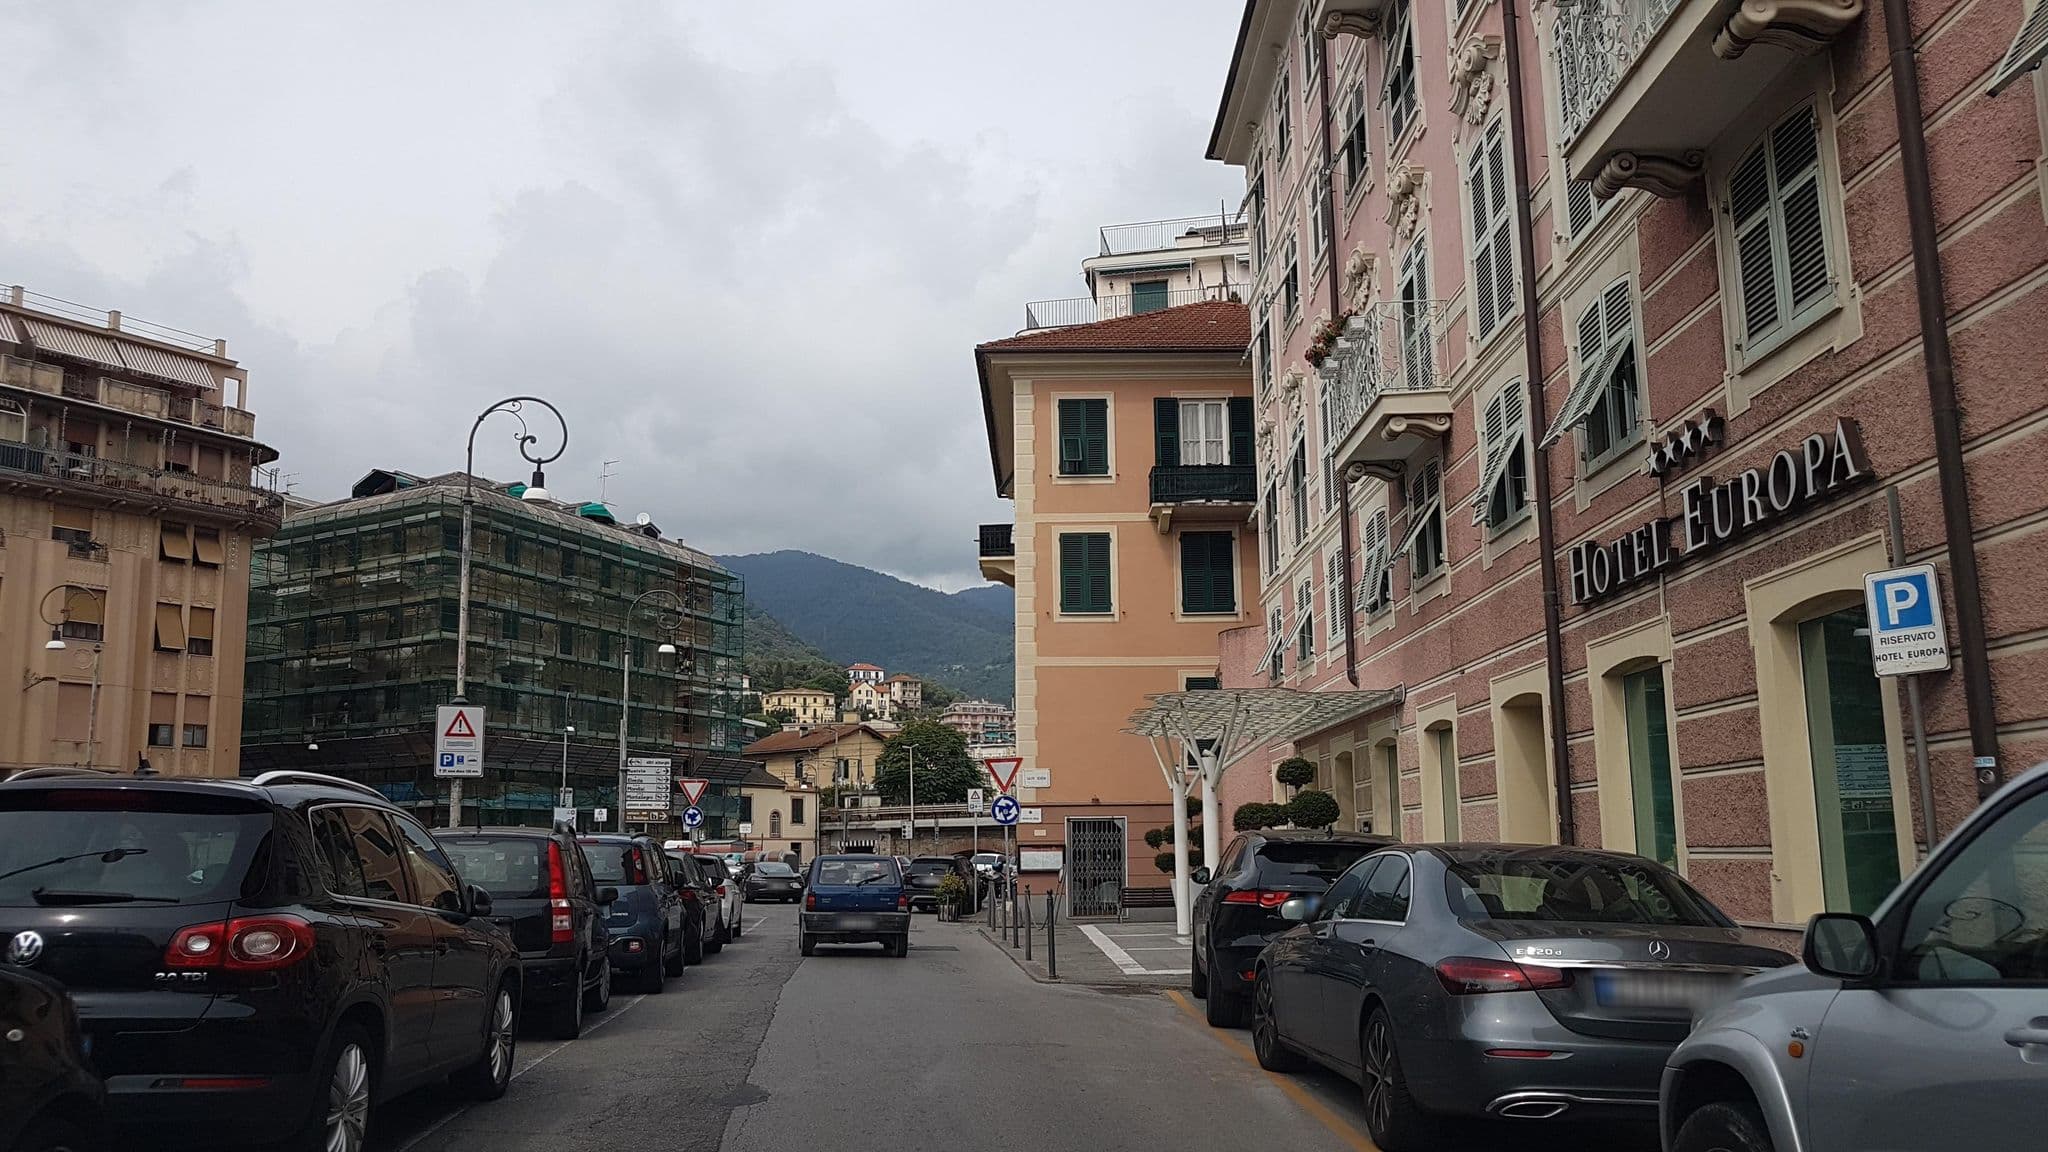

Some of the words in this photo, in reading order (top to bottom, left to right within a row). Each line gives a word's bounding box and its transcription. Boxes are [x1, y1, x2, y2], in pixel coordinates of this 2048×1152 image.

[1568, 518, 1675, 604] HOTEL
[1680, 416, 1866, 553] EUROPA
[1884, 581, 1919, 625] P
[1880, 631, 1936, 645] RISERVATO
[1875, 652, 1904, 662] HOTEL
[1907, 647, 1945, 659] EUROPA
[443, 755, 453, 766] P
